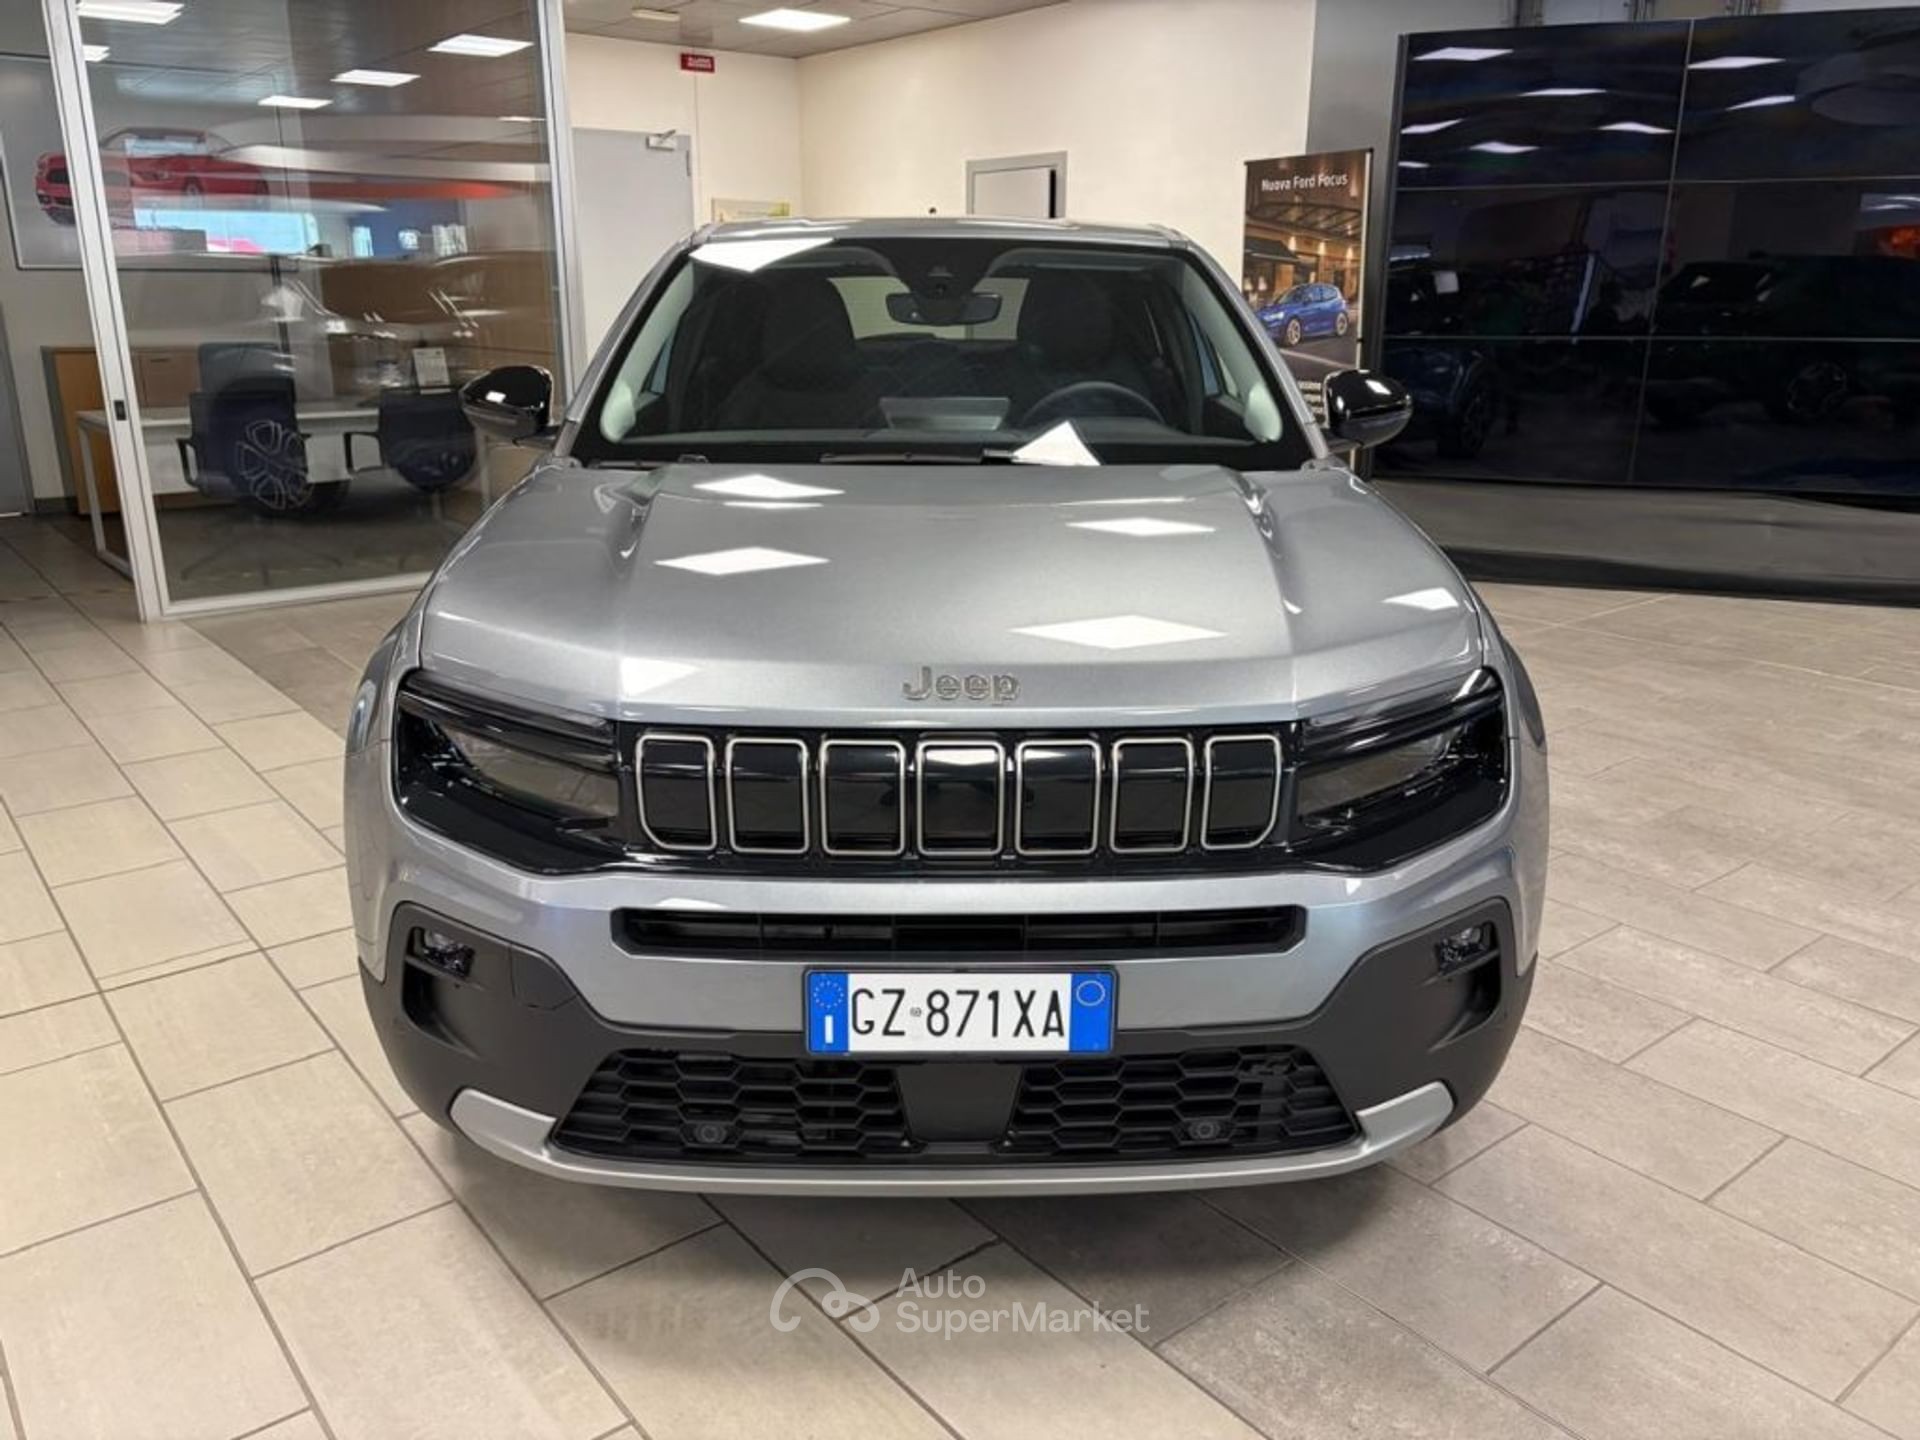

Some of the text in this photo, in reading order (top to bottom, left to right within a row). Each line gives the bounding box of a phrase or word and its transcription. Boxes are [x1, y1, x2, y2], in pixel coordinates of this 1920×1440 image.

[1261, 172, 1348, 192] Nuova Ford Focus
[902, 665, 1019, 706] Jeep
